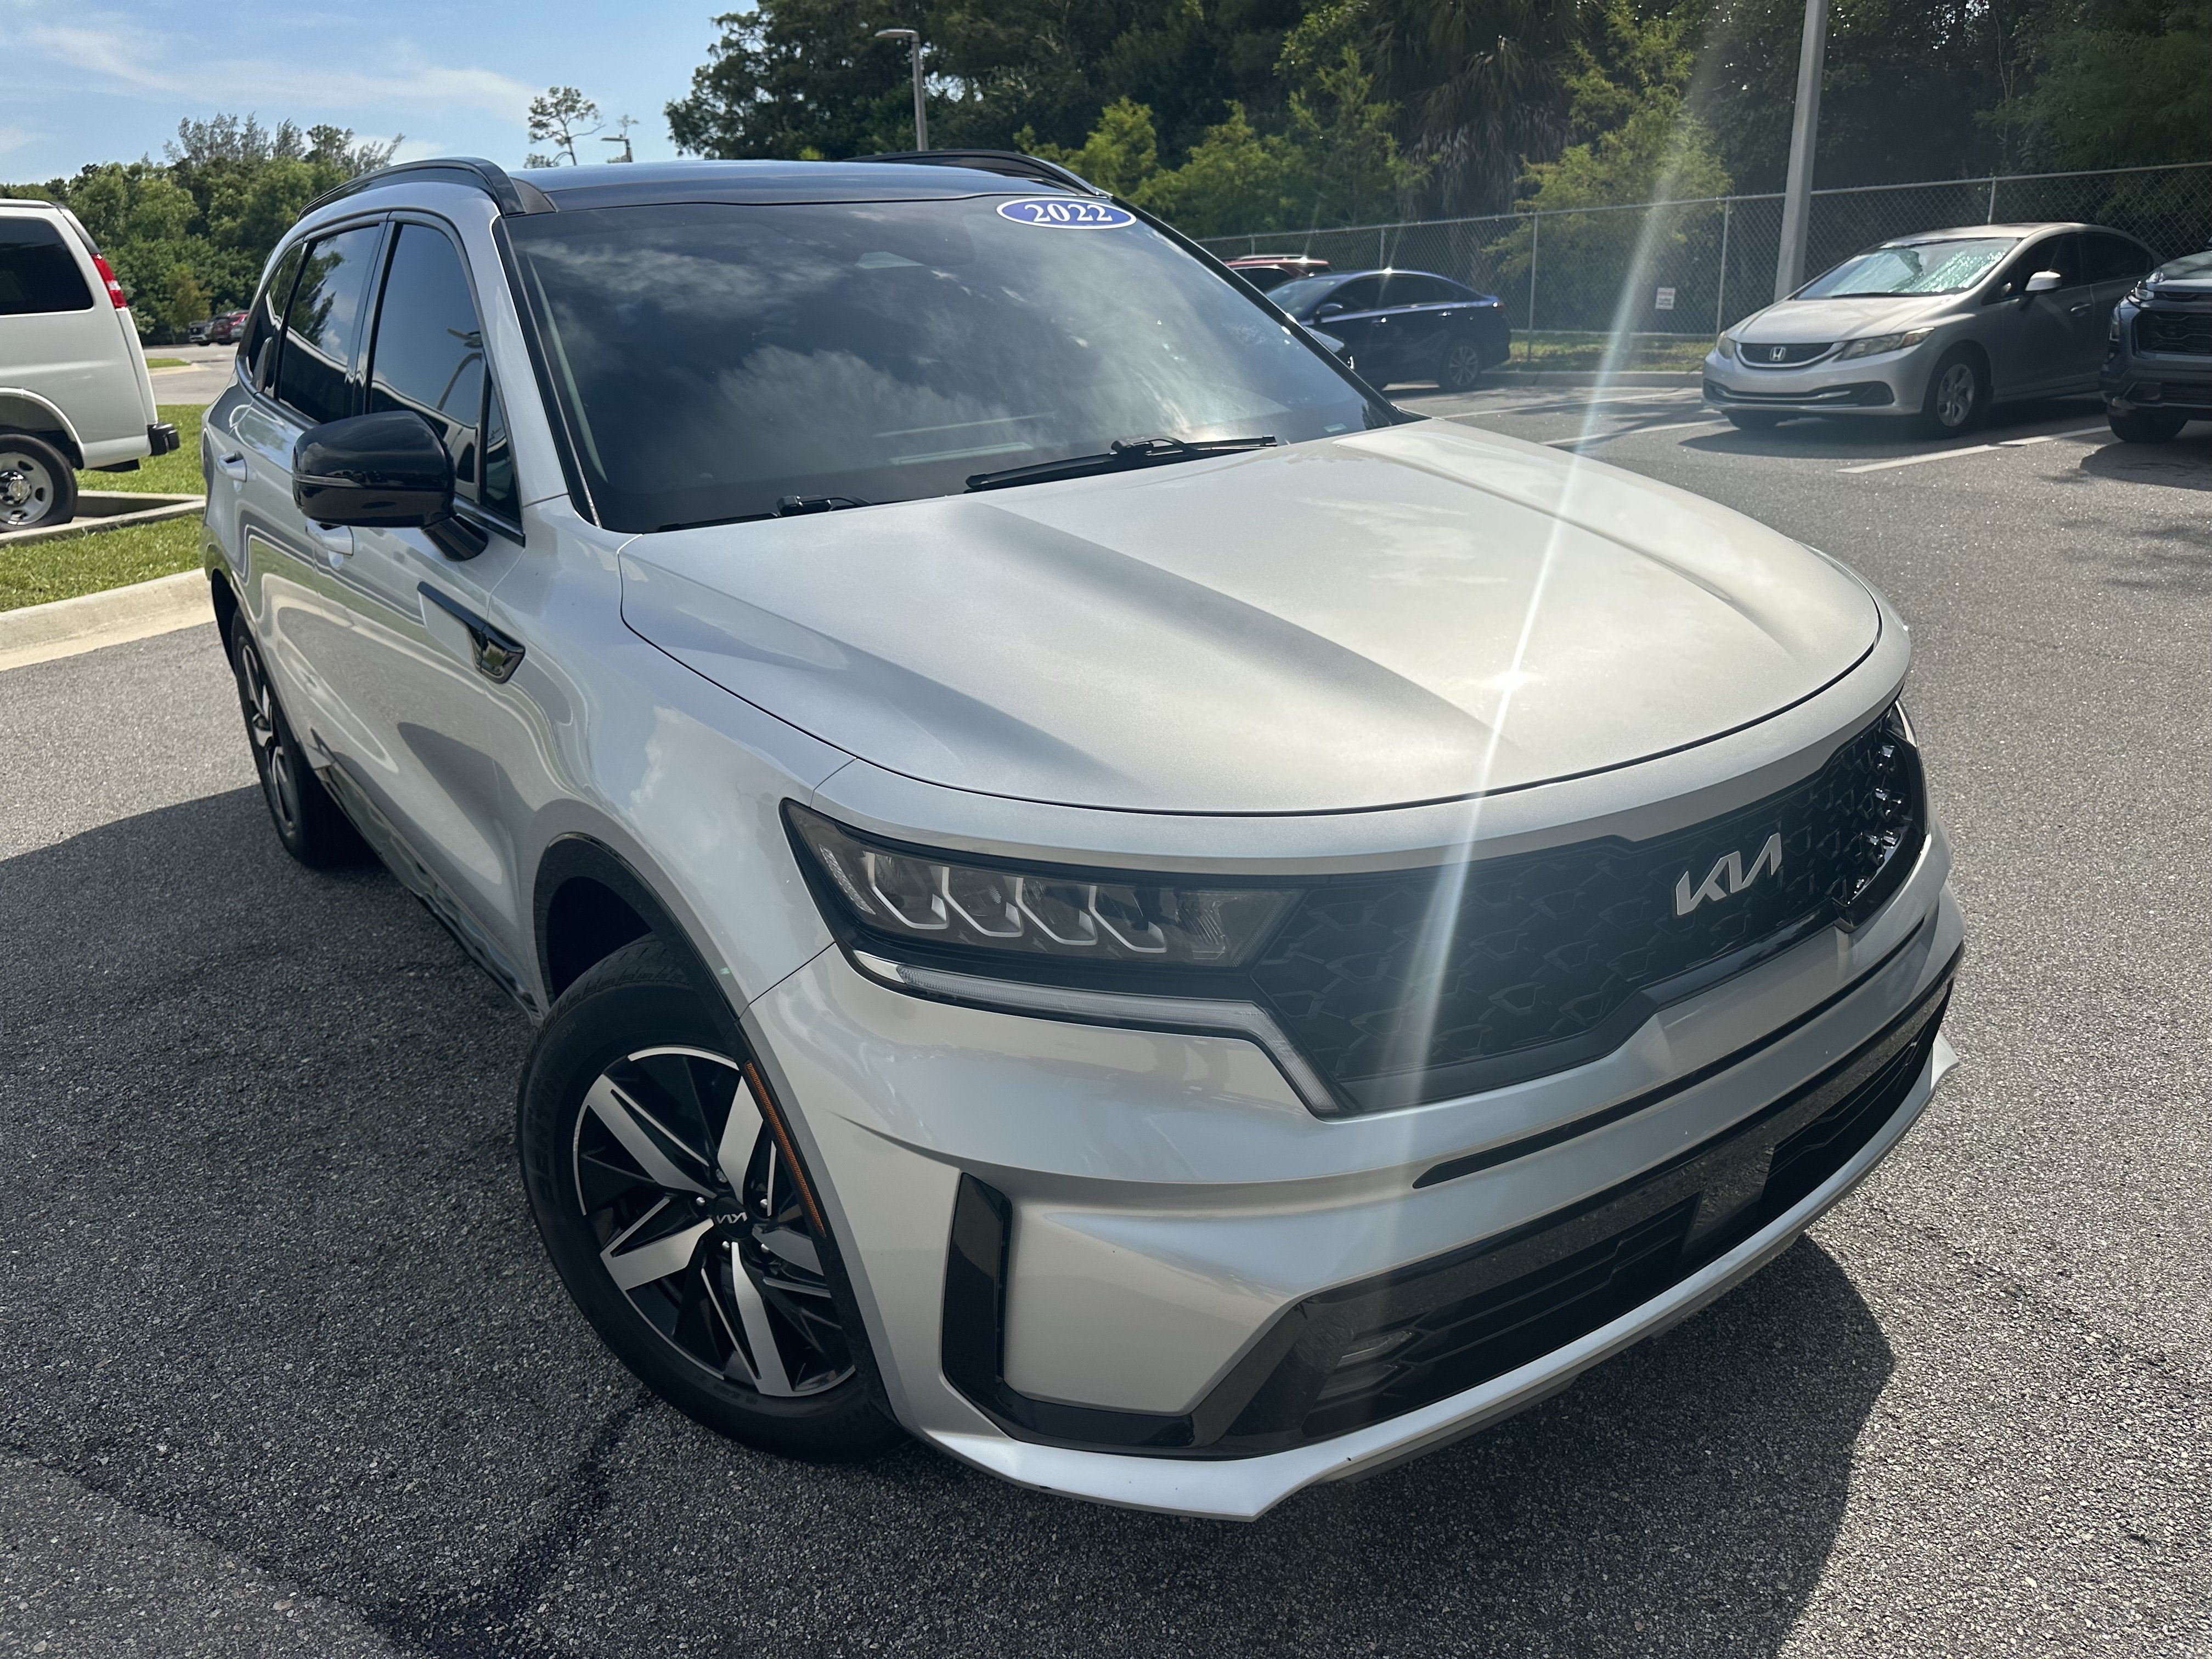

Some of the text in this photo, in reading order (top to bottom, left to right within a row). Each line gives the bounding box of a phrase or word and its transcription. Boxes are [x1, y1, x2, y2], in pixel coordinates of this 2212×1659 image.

[1024, 204, 1113, 222] 2022
[1676, 832, 1782, 916] KIA
[716, 1212, 747, 1224] KIA
